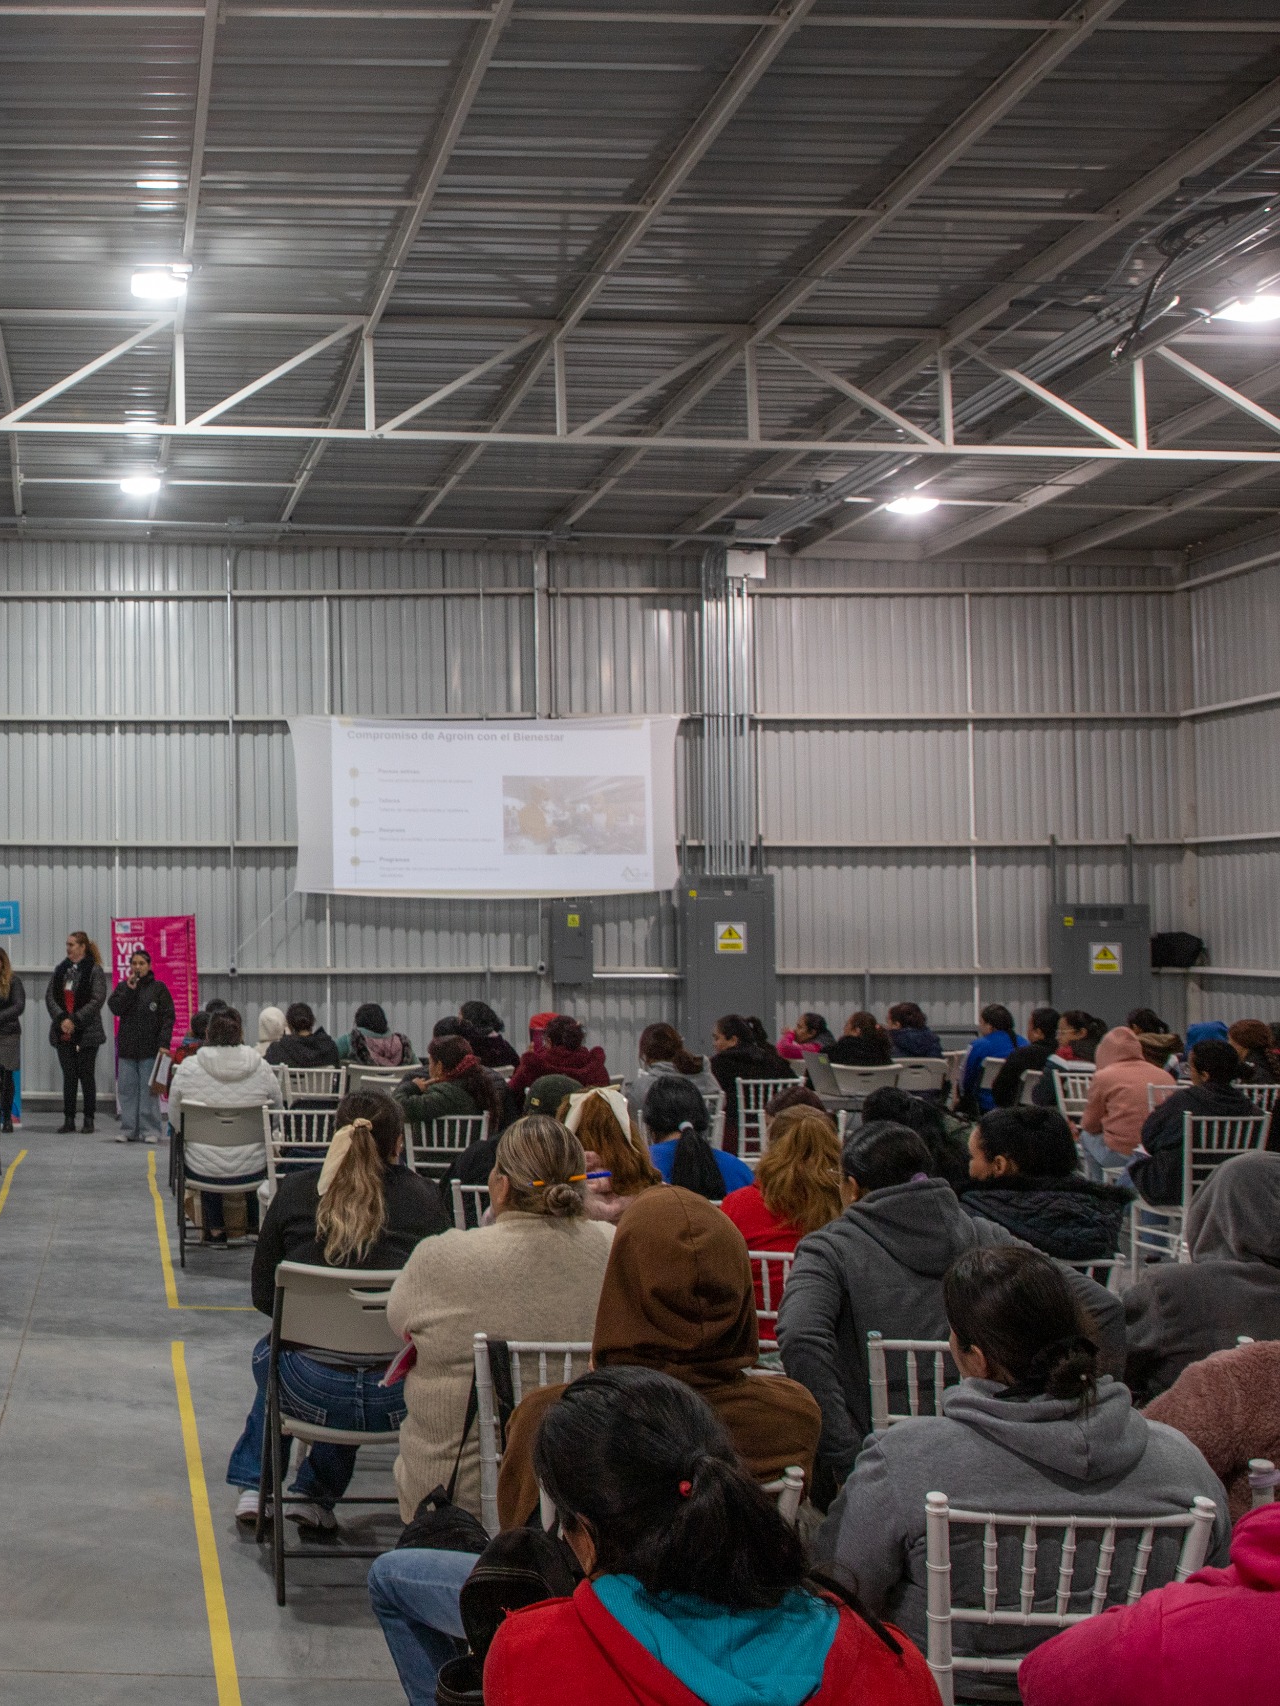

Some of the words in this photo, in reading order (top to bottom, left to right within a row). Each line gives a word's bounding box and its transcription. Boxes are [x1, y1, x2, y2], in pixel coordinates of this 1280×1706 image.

[347, 730, 418, 742] Compromiso
[421, 731, 435, 741] de
[437, 731, 474, 743] Agroin
[477, 733, 497, 742] con
[500, 732, 510, 742] el
[513, 732, 565, 743] Bienestar
